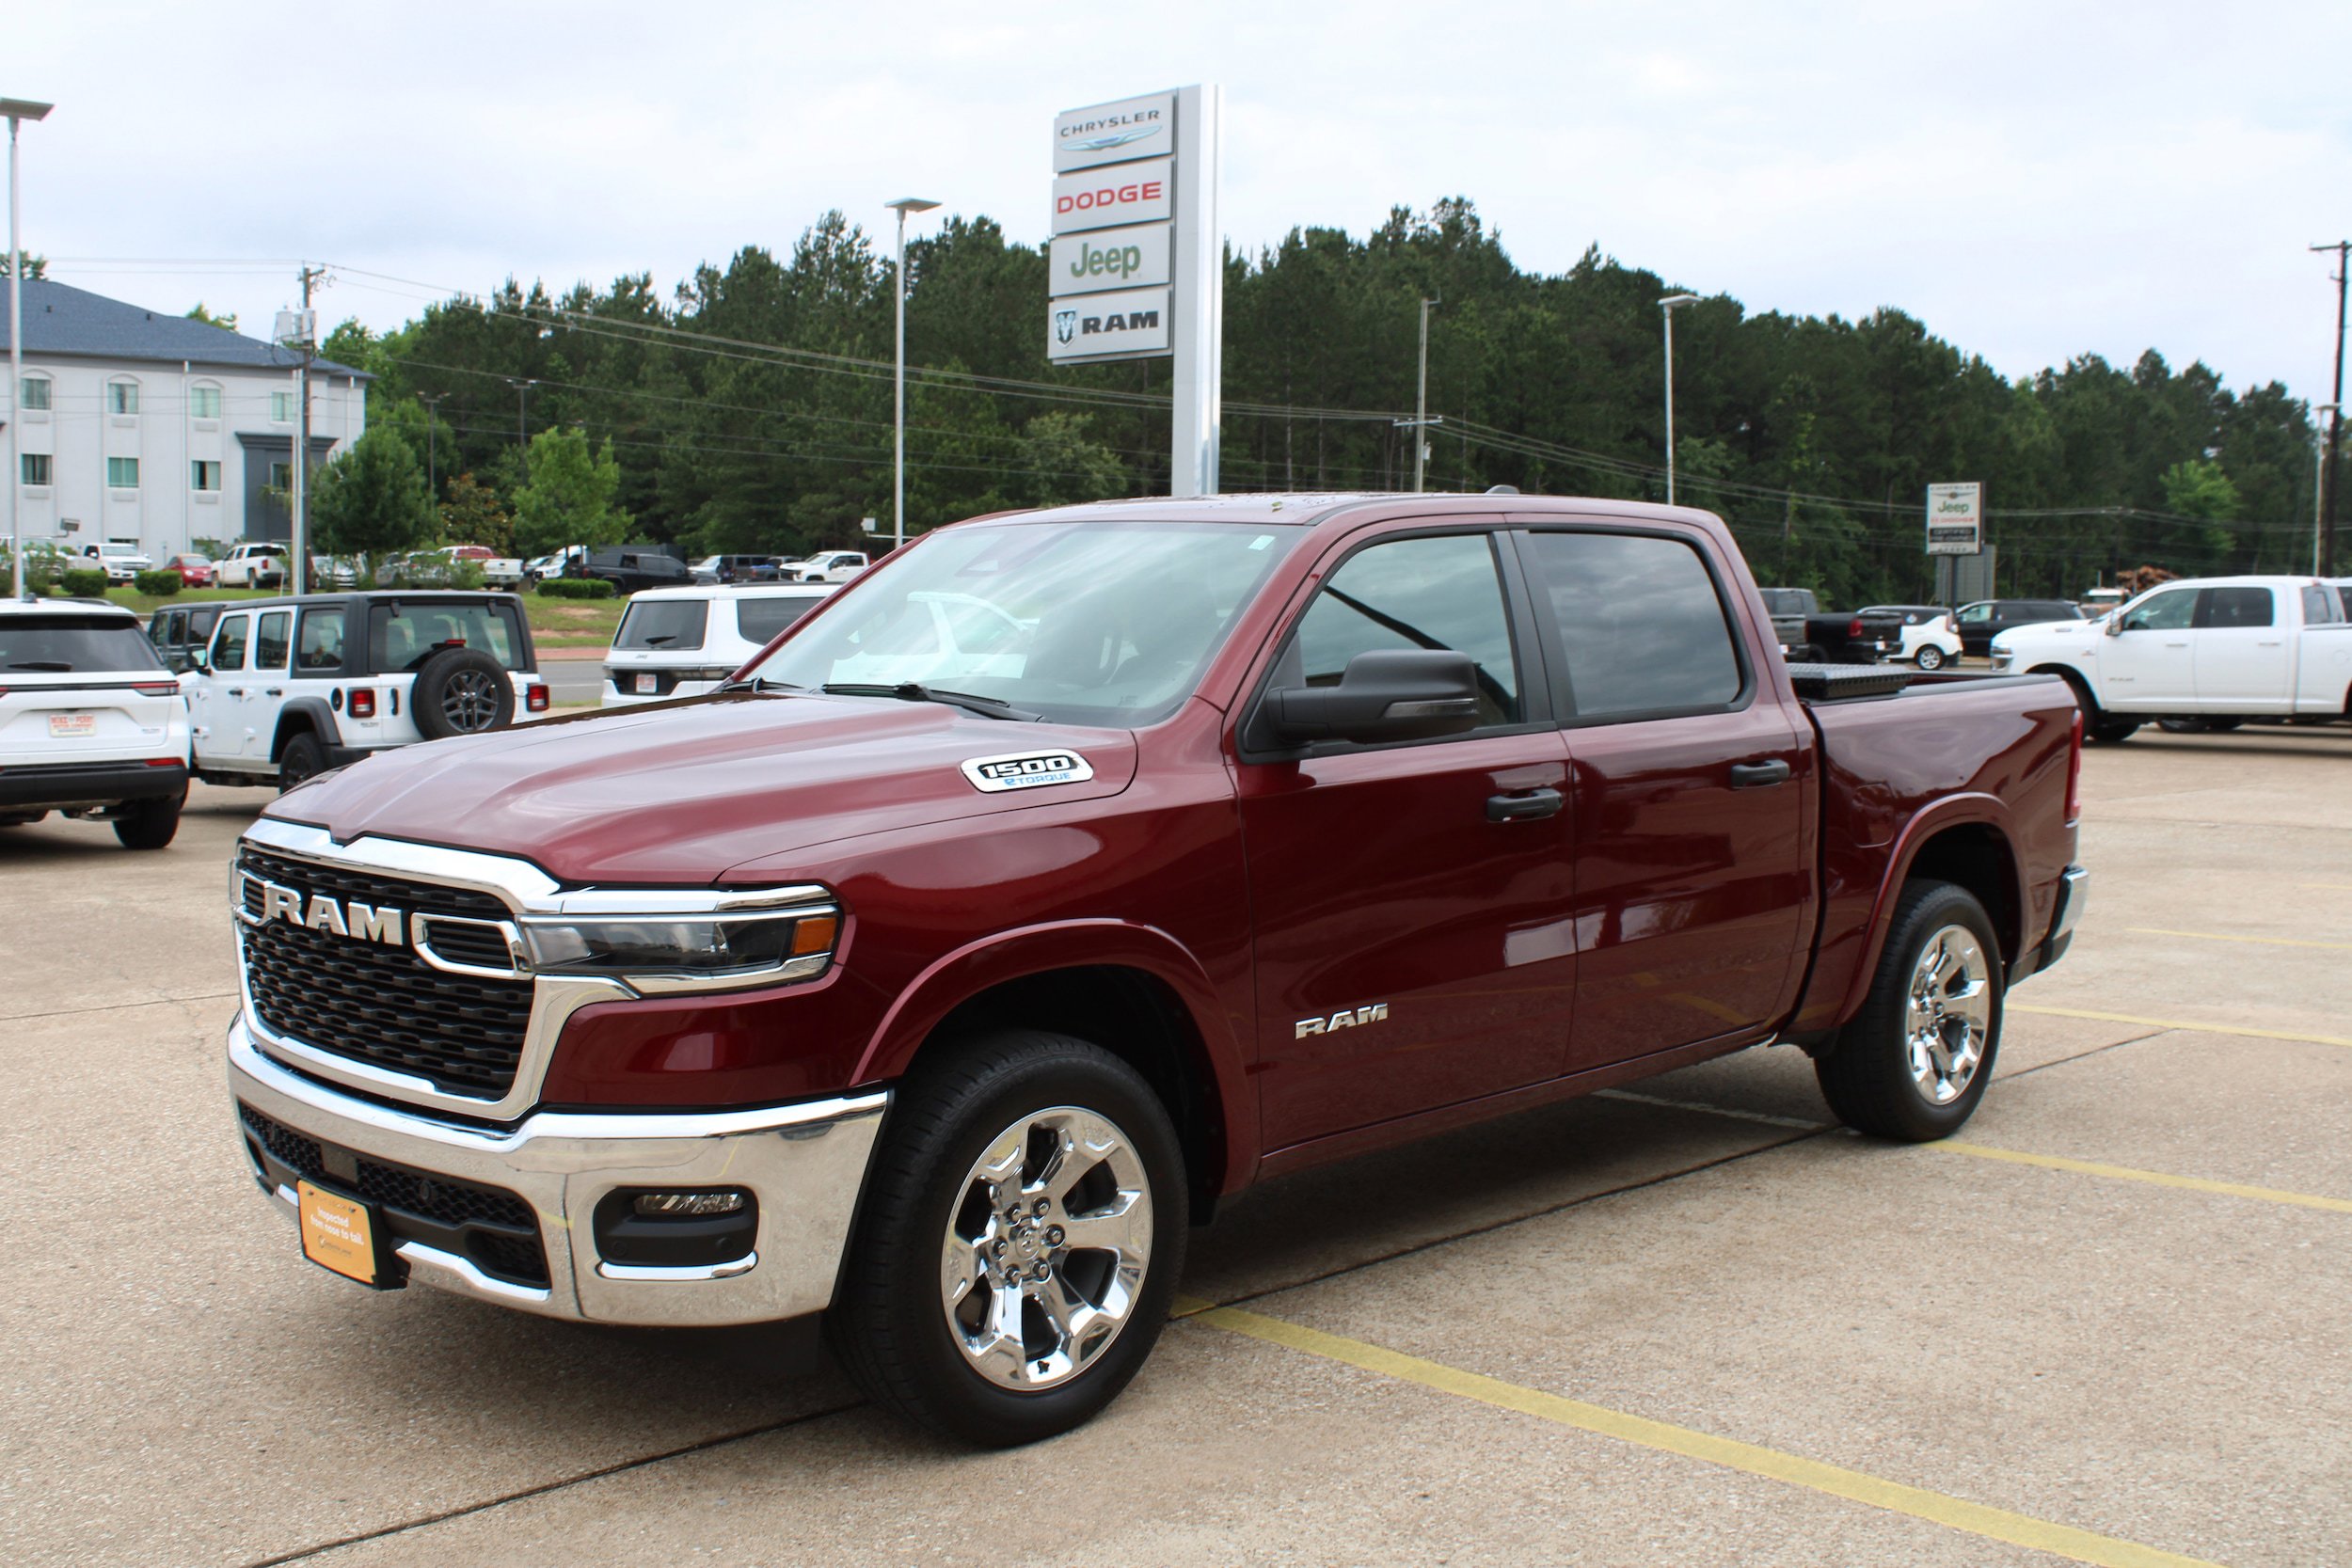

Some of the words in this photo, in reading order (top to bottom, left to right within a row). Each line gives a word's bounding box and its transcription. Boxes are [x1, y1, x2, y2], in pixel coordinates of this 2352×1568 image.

[1060, 109, 1160, 137] CHRYSLER
[1057, 182, 1162, 214] DODGE
[1071, 243, 1140, 279] Jeep
[1082, 310, 1159, 334] RAM
[1938, 500, 1969, 515] Jeep
[981, 756, 1071, 779] 1500
[264, 881, 403, 946] RAM
[1295, 1003, 1389, 1039] RAM
